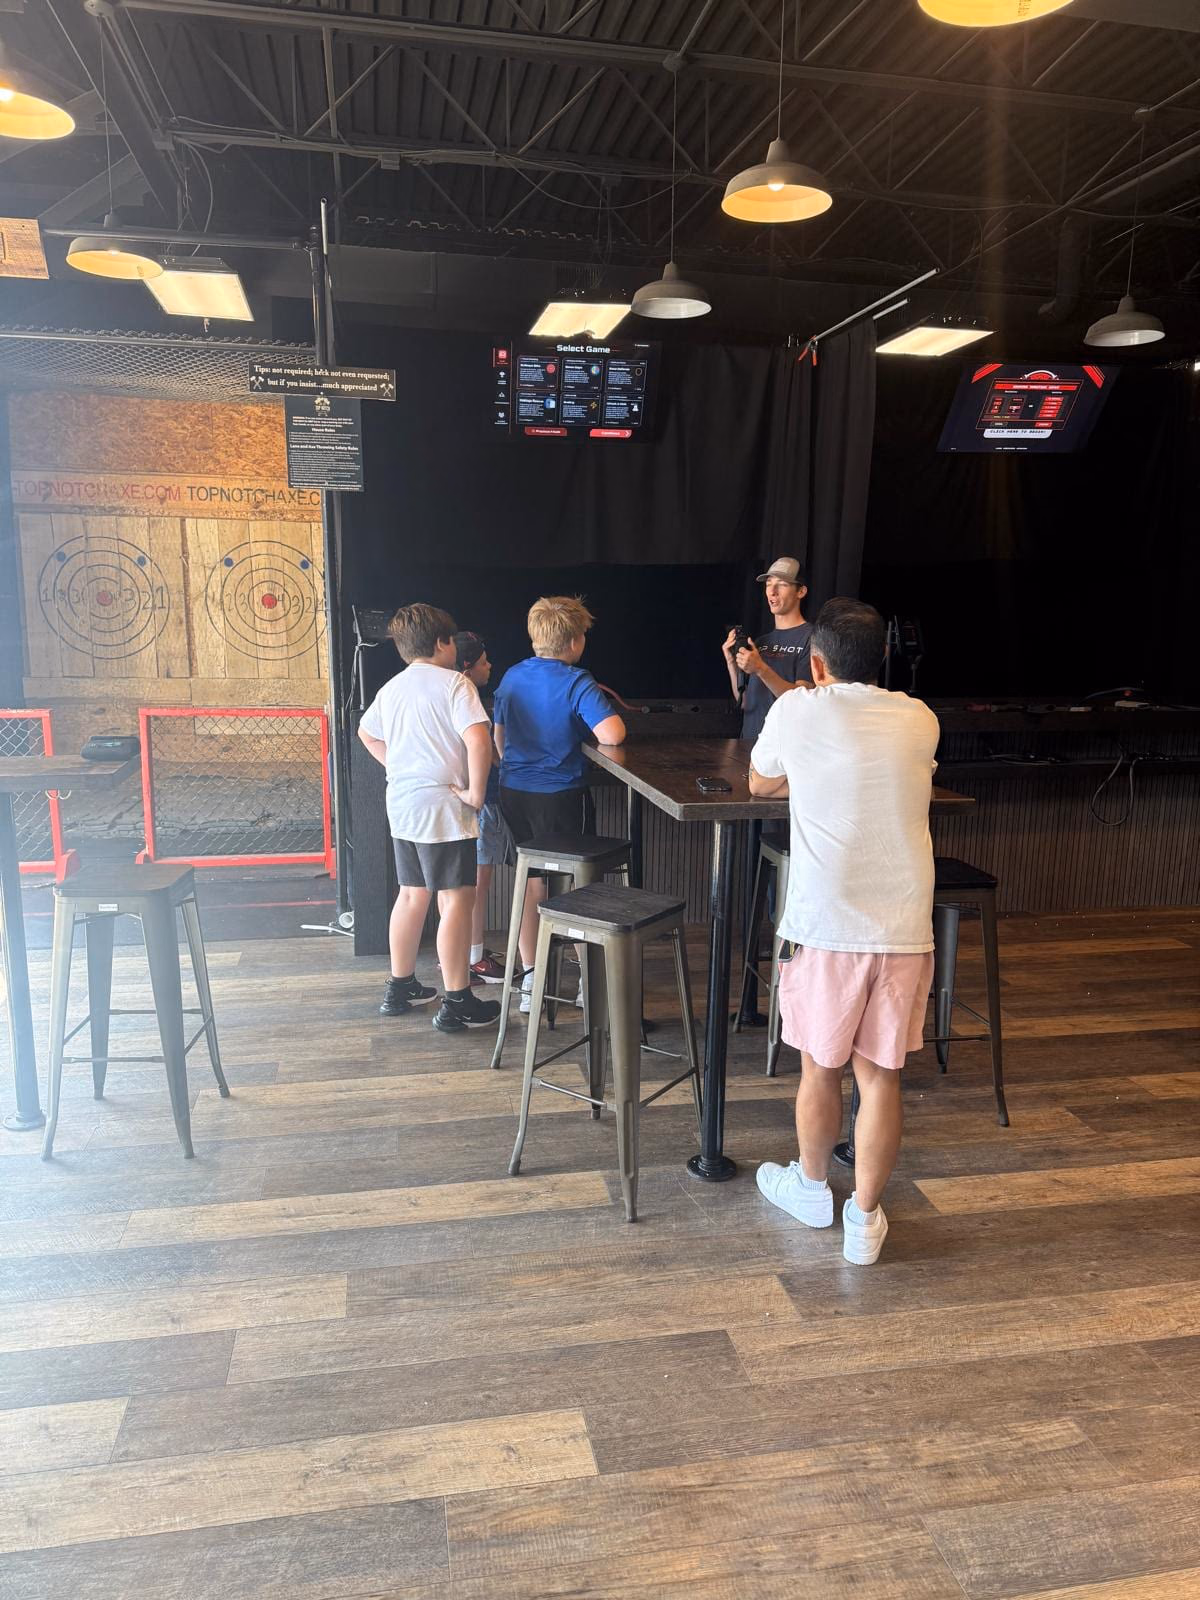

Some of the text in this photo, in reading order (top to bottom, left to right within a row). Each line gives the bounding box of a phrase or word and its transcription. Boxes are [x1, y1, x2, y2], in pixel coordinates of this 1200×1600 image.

[557, 344, 584, 353] Select
[253, 365, 271, 375] Tips:
[284, 368, 314, 376] required;
[314, 368, 329, 377] heck
[357, 373, 390, 381] requested;
[267, 378, 279, 386] but
[280, 378, 286, 386] if
[341, 383, 378, 391] appreciated
[122, 588, 137, 614] 3
[141, 591, 151, 610] 2
[155, 585, 167, 609] 1
[239, 592, 249, 613] 3
[291, 594, 301, 615] 3
[305, 596, 315, 613] 2
[772, 644, 804, 654] SHOT
